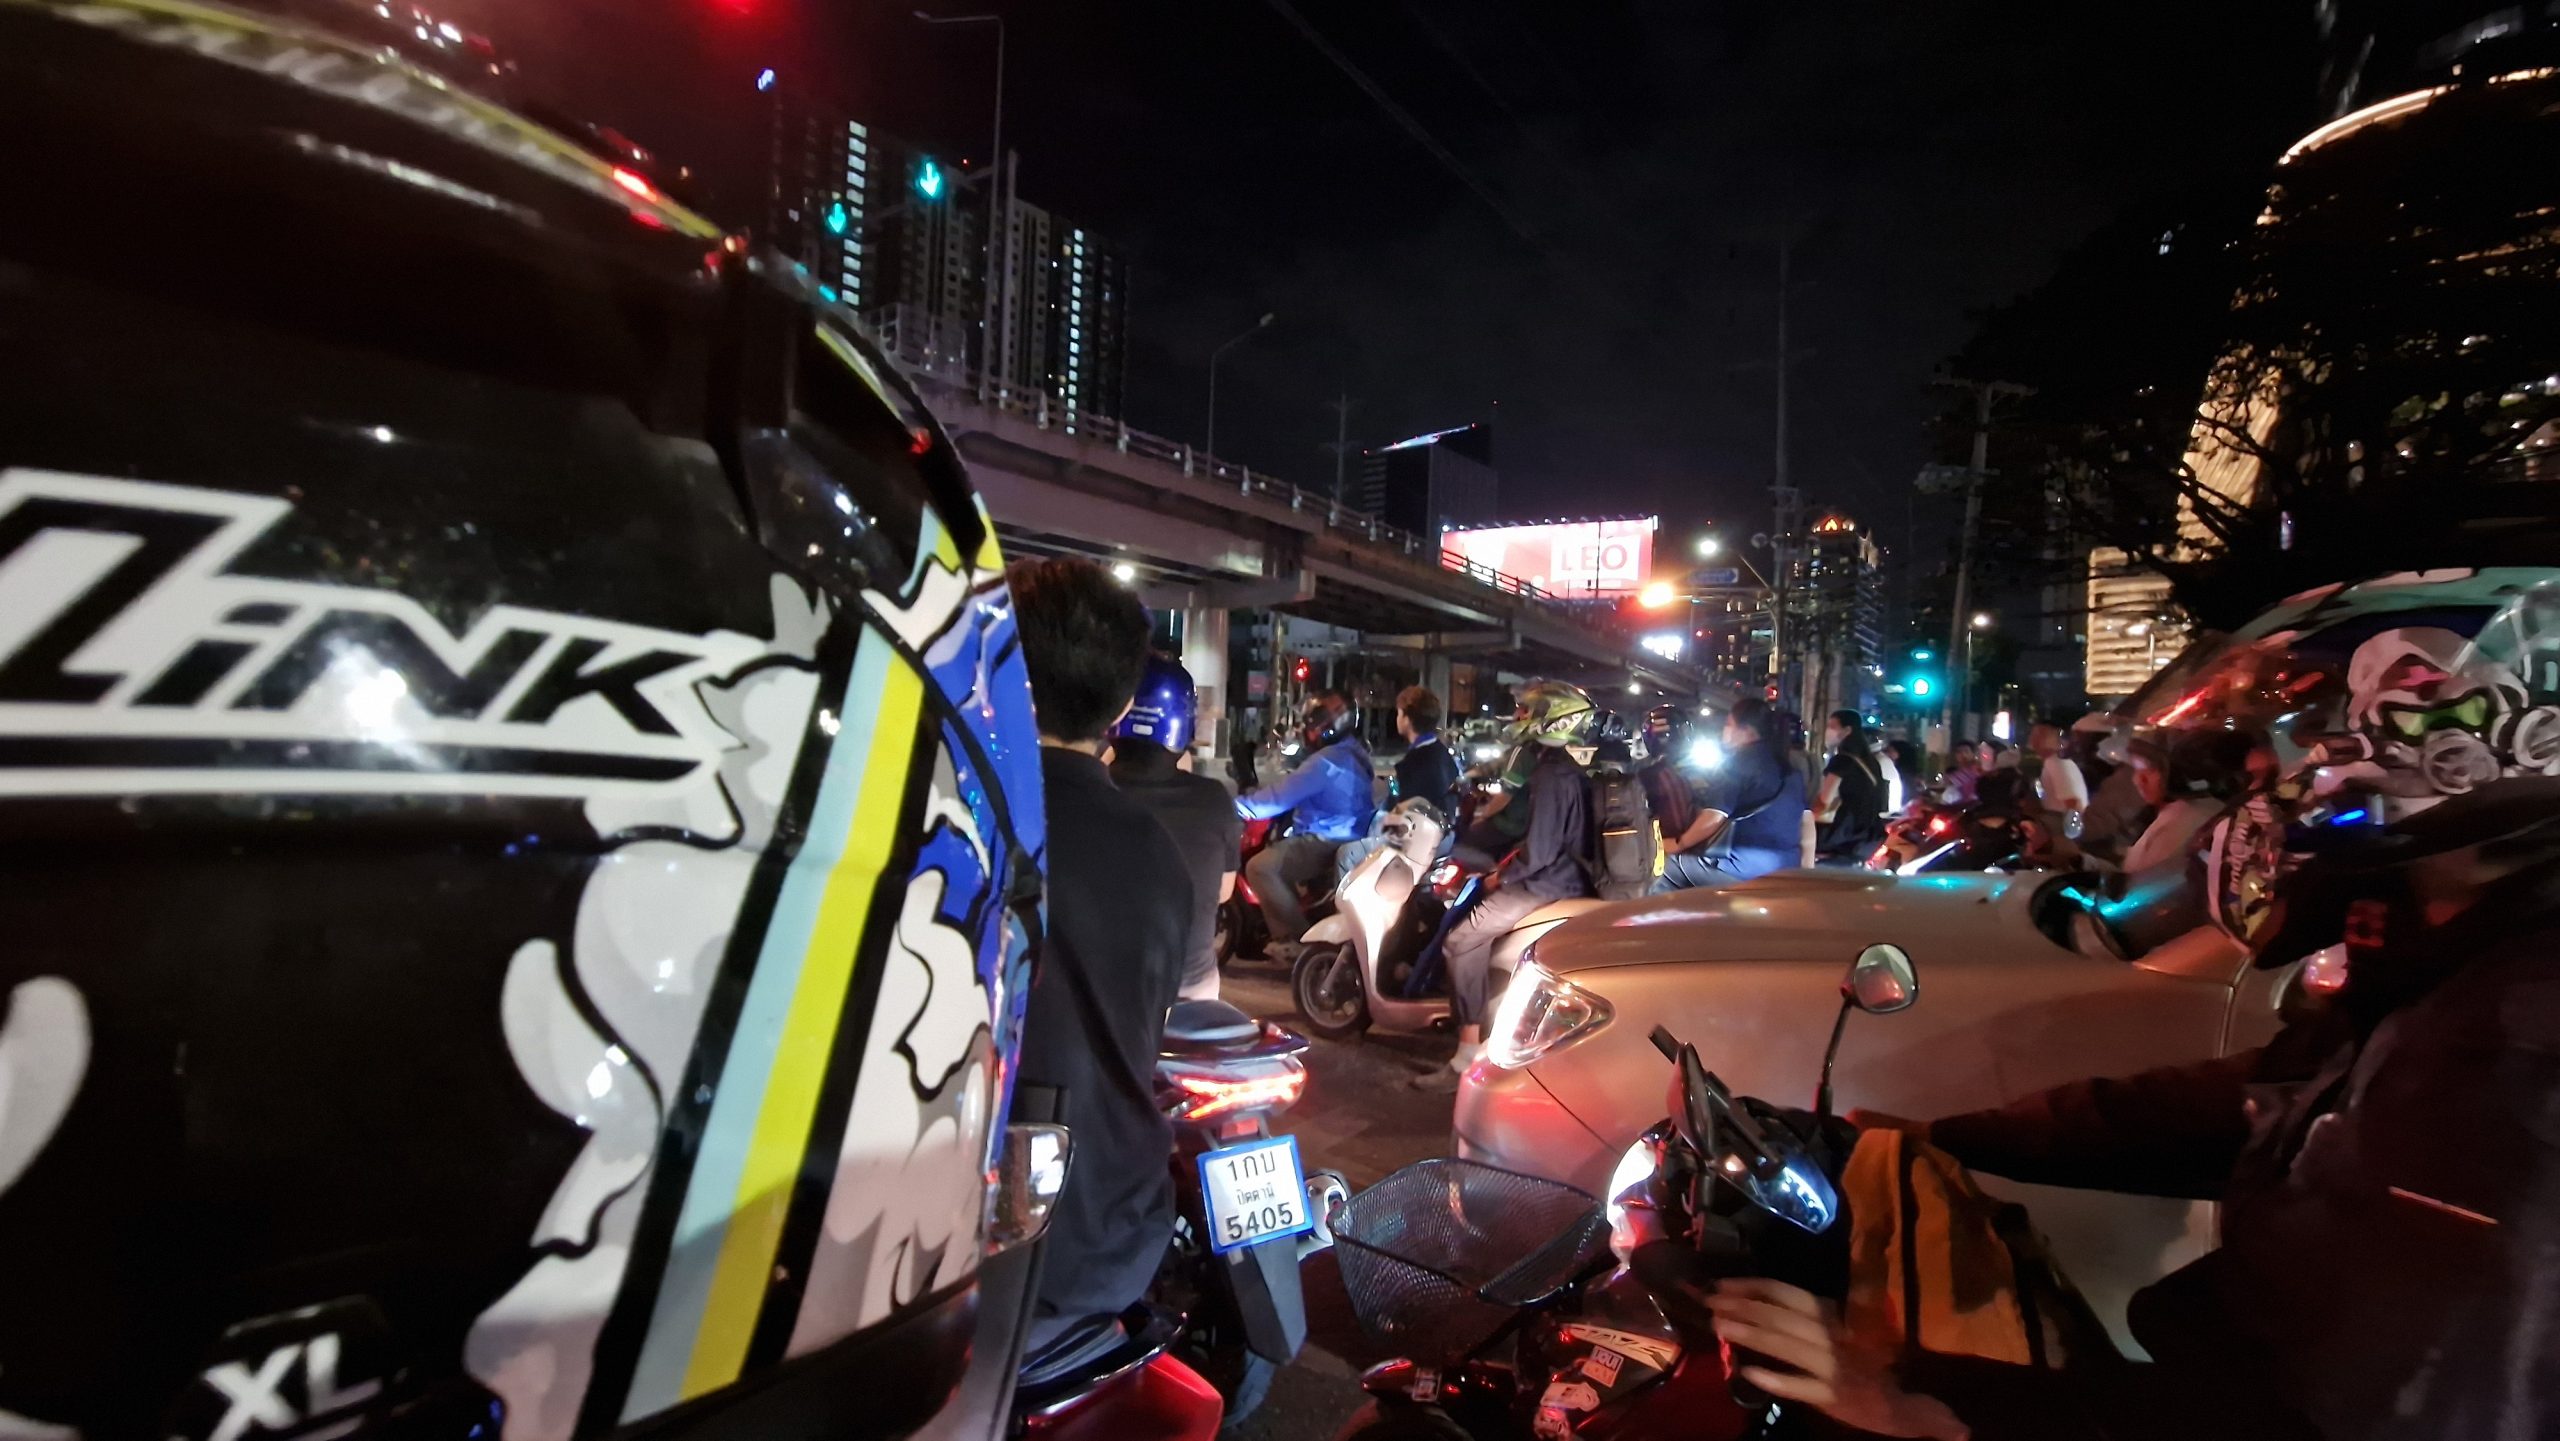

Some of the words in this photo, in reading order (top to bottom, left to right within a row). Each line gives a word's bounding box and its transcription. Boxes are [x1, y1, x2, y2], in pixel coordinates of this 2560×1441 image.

[1561, 544, 1628, 571] LEO
[1227, 1151, 1276, 1181] 1กบ
[1225, 1201, 1293, 1241] 5405
[202, 1332, 383, 1441] XL
